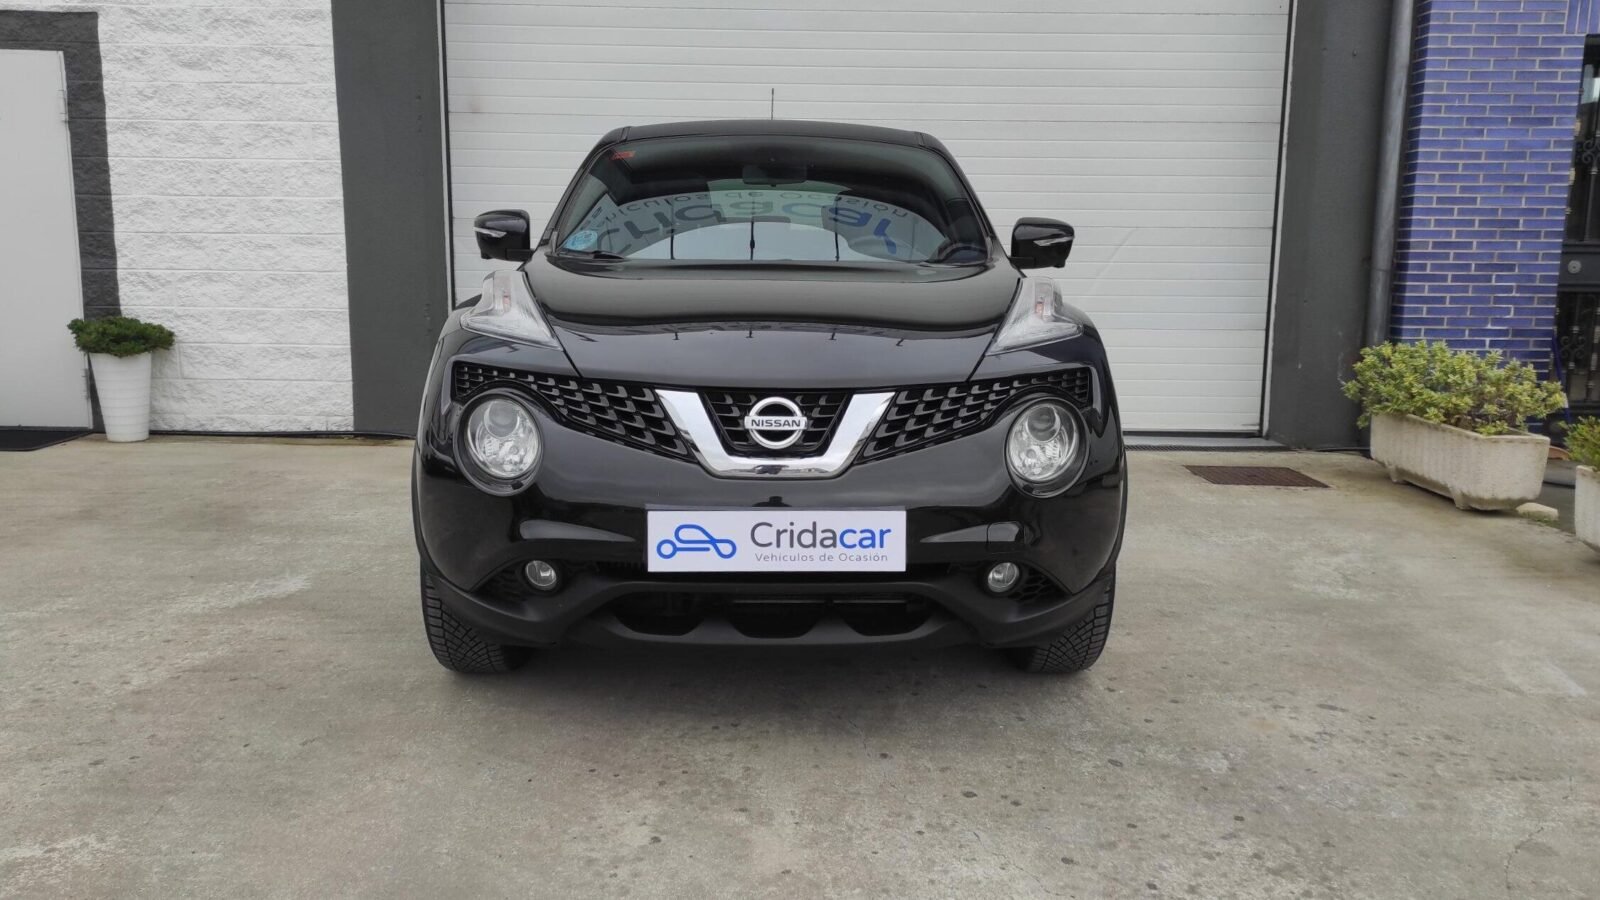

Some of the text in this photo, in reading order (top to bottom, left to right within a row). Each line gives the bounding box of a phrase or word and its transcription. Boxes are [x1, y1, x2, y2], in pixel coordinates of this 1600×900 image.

[751, 419, 801, 428] NISSAN
[750, 521, 892, 549] Cridacar
[819, 553, 834, 562] de
[838, 552, 888, 562] Ocasión
